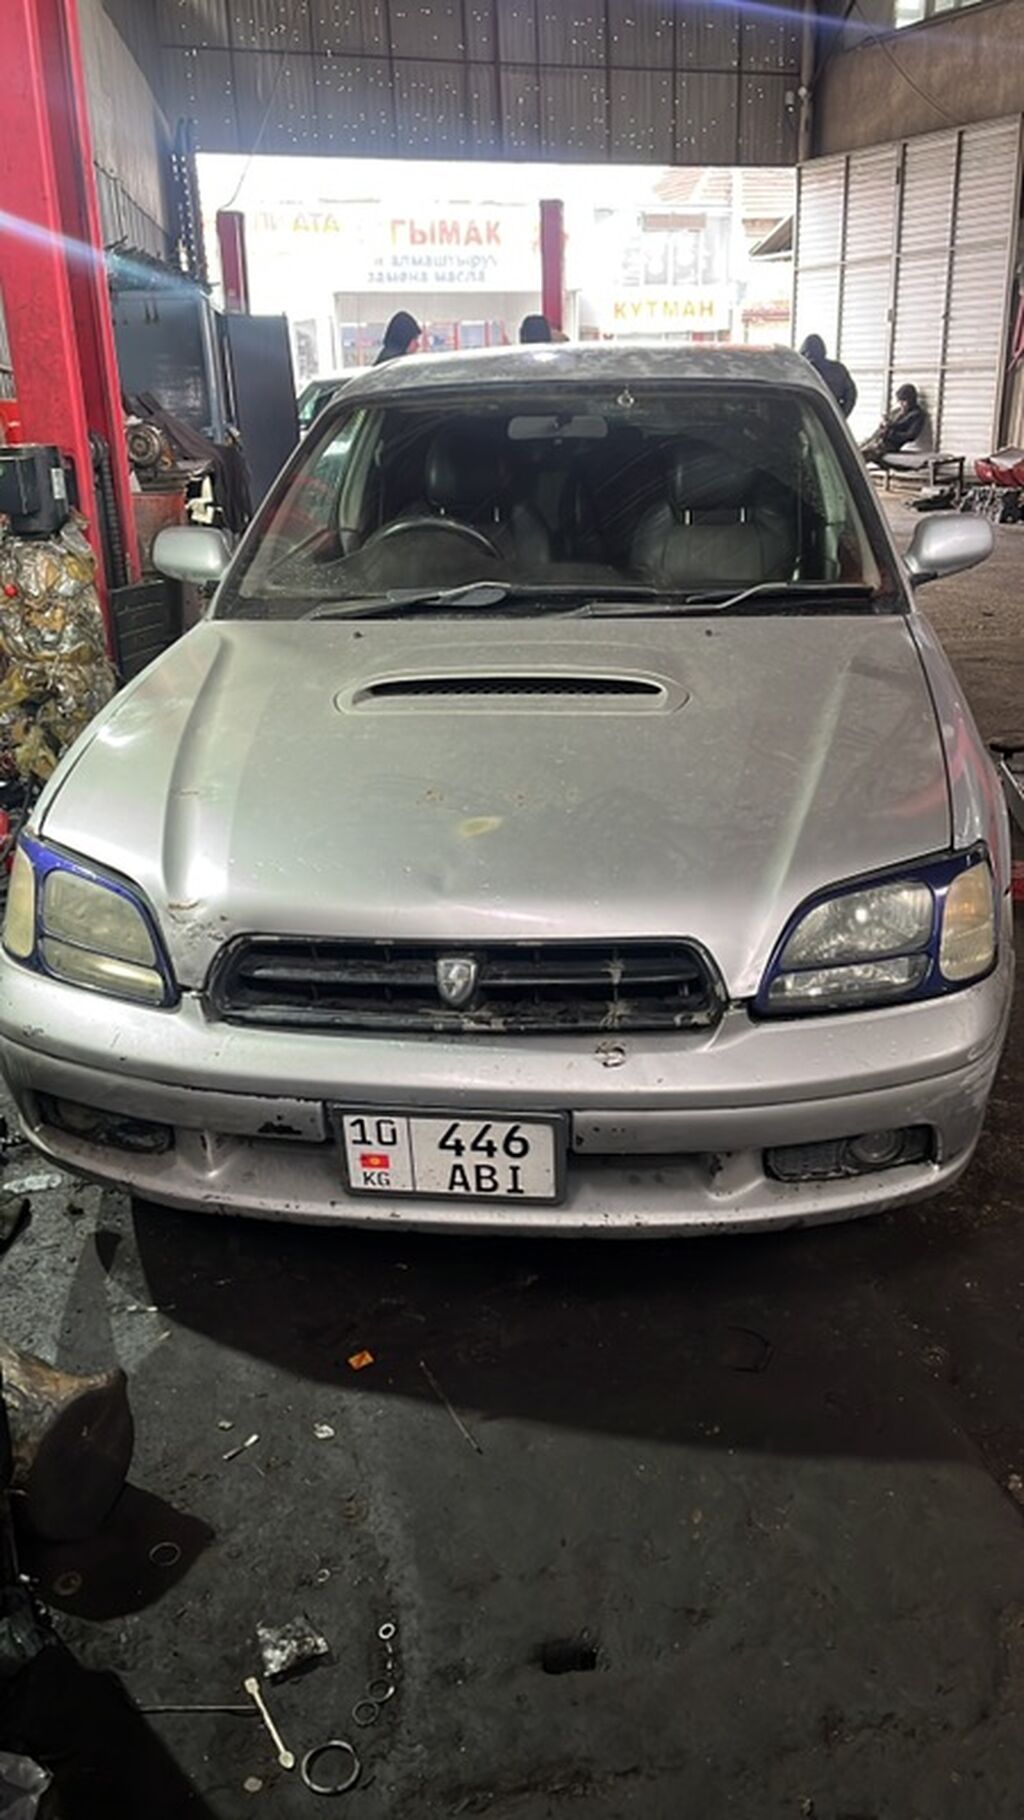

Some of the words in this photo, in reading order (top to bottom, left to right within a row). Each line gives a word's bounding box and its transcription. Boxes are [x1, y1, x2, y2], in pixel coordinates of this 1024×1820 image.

[613, 299, 715, 319] КУТМАН
[350, 1118, 398, 1146] 10
[438, 1122, 530, 1159] 446
[362, 1171, 391, 1187] KG
[448, 1163, 524, 1194] ABI
